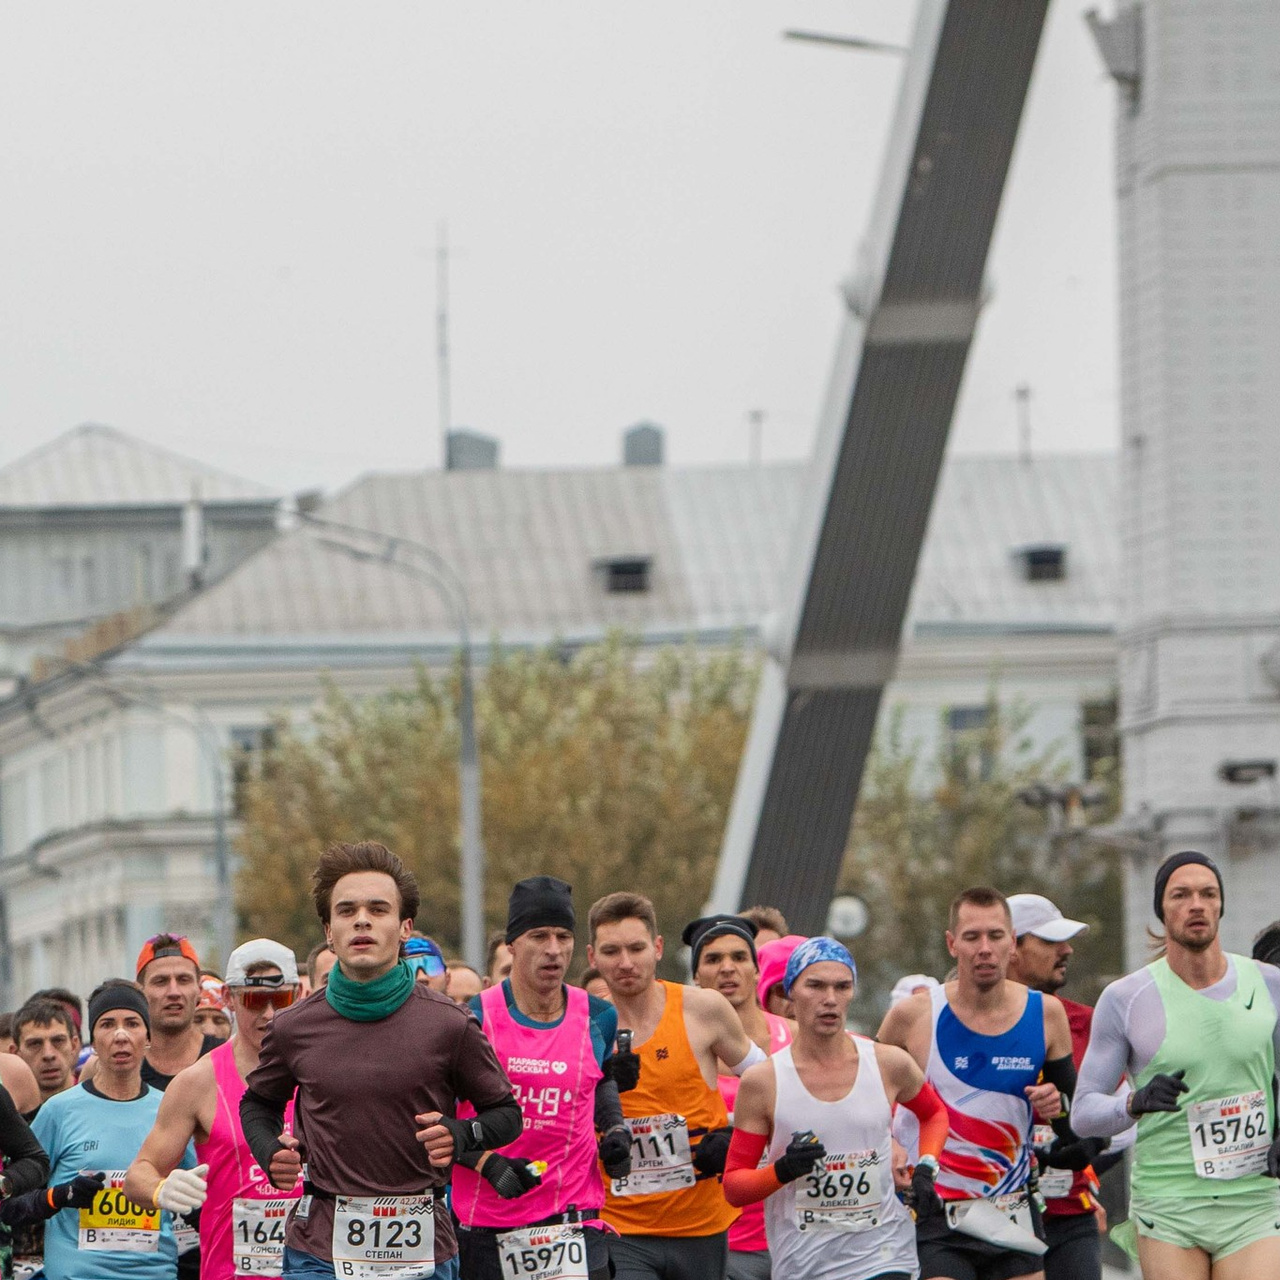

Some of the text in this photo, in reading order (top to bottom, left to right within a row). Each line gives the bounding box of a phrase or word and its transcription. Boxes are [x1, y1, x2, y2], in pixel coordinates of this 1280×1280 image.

[1195, 1111, 1267, 1148] 15762
[1218, 1140, 1255, 1155] ВАСИЛИЙ
[806, 1171, 871, 1198] 3696
[820, 1198, 859, 1207] АЛЕКСЕЙ
[107, 1218, 136, 1227] ЛИДИЯ
[347, 1219, 422, 1248] 8123
[250, 1246, 283, 1254] КОНСТА
[365, 1250, 403, 1259] СТЕПАН
[506, 1241, 582, 1276] 15970
